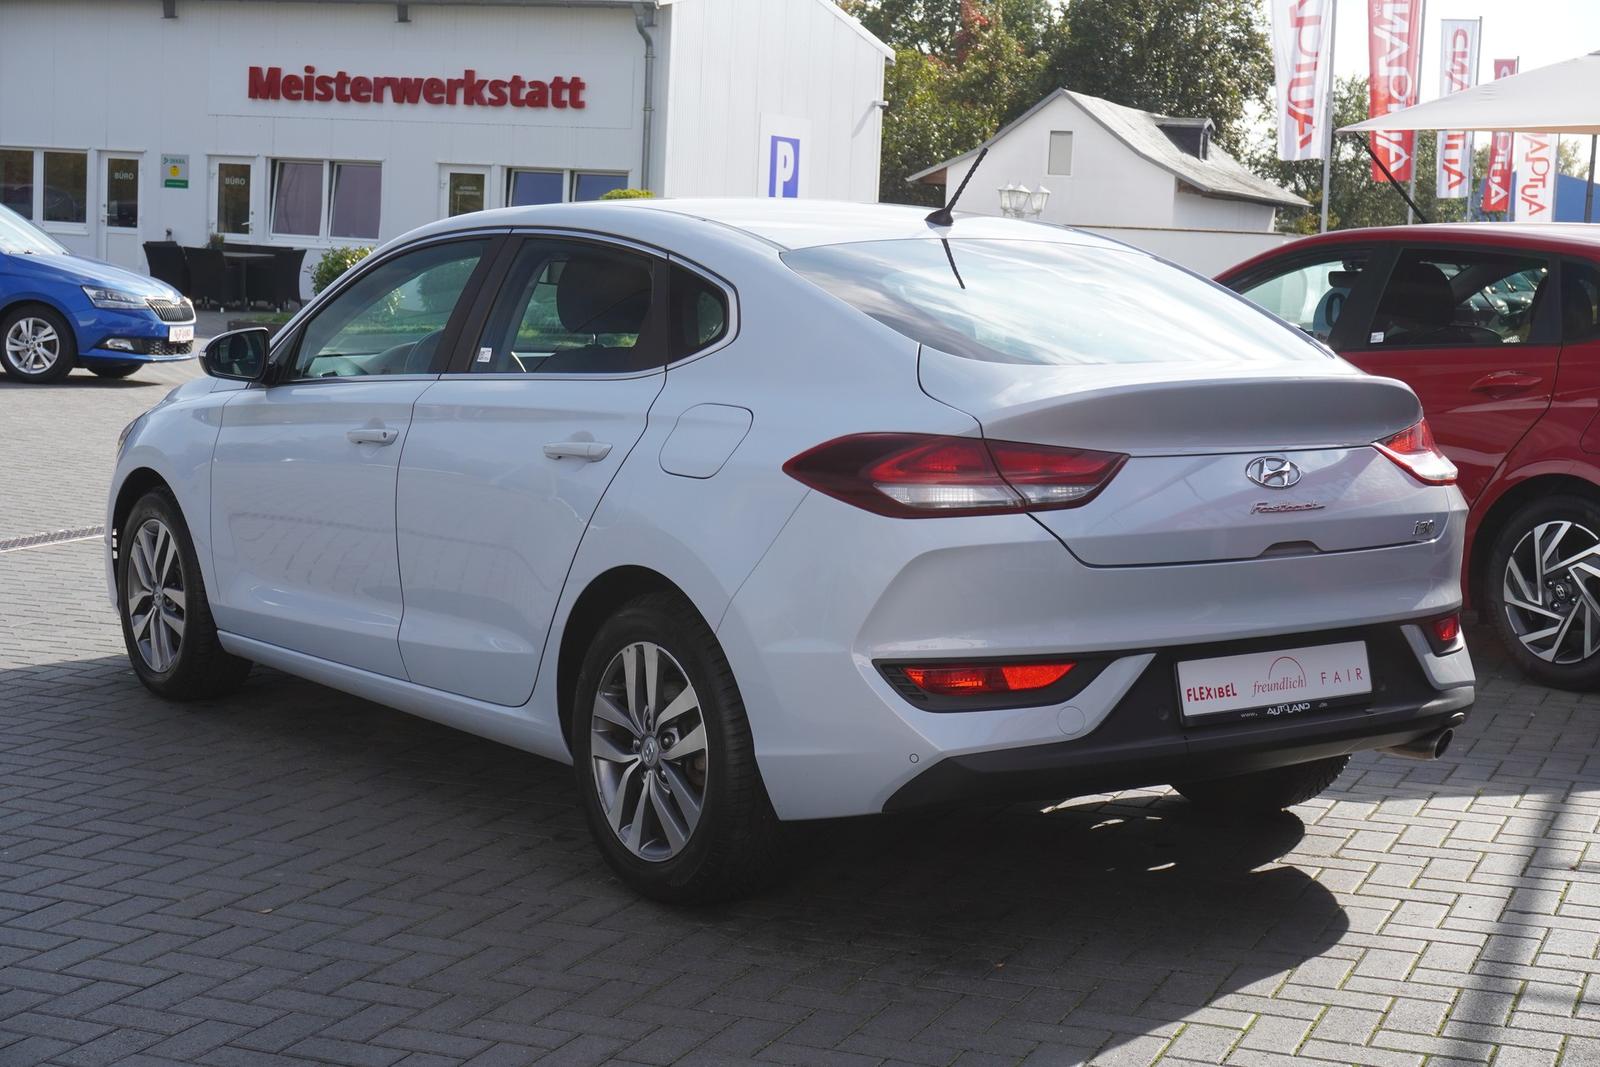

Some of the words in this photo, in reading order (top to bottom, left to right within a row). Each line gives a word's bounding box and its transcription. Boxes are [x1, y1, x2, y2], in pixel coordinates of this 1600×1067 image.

[248, 65, 586, 109] Meisterwerkstatt
[114, 171, 135, 180] BÜRO
[775, 140, 795, 198] P
[225, 176, 246, 186] BÜRO
[1186, 682, 1238, 702] FLEXIBEL
[1251, 675, 1303, 697] freundlich
[1266, 702, 1311, 716] AUTOLAND
